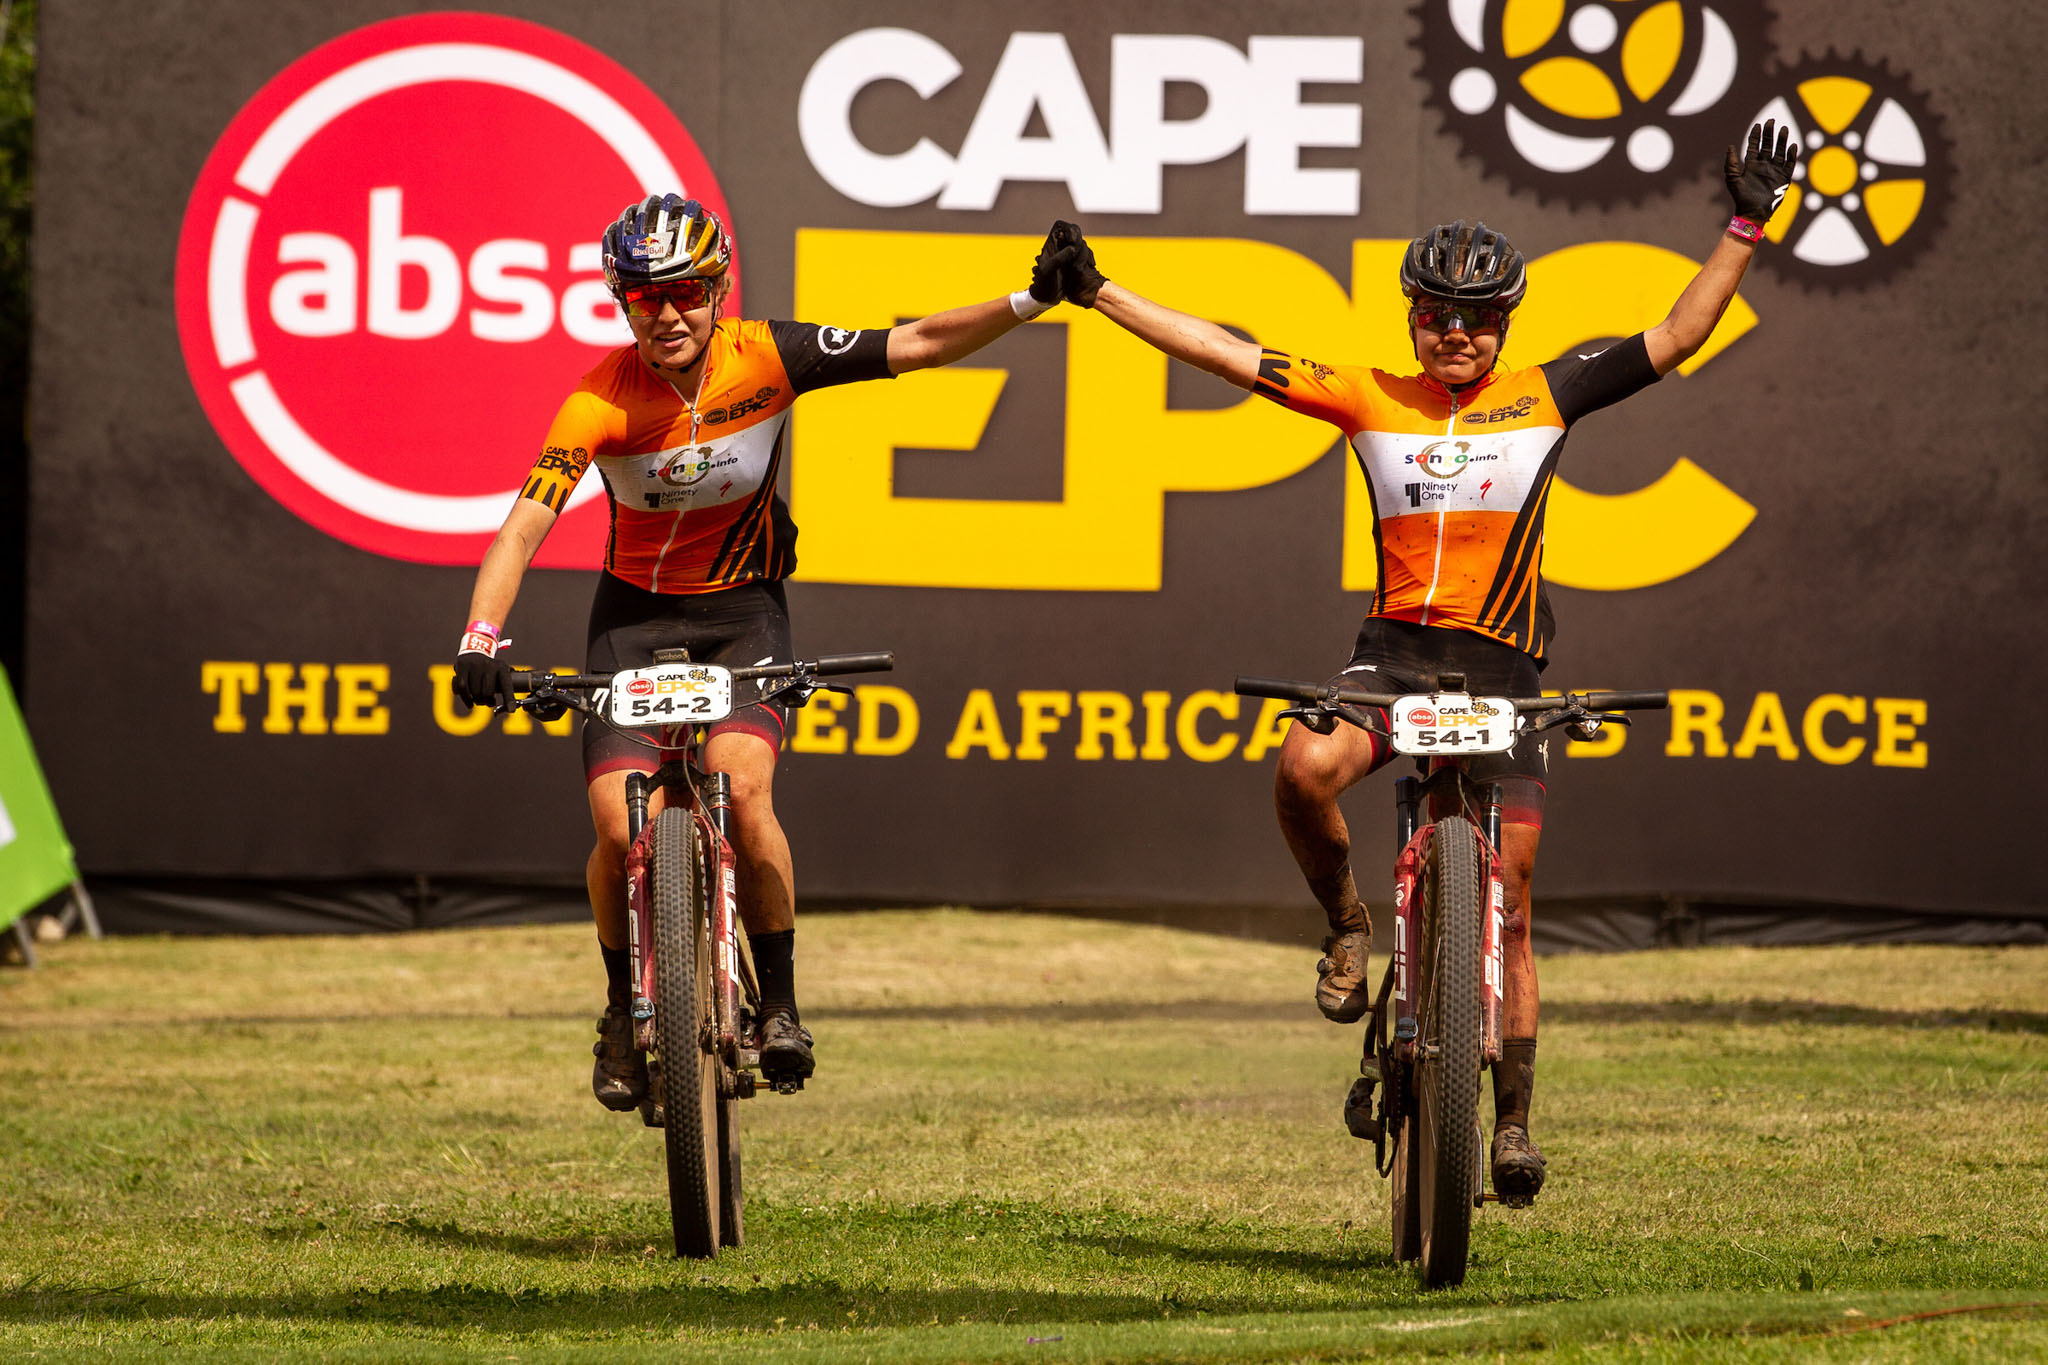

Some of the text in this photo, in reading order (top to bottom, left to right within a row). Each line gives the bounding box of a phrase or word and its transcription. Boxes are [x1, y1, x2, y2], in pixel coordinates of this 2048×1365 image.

[797, 27, 1364, 216] CAPE
[729, 398, 770, 421] EPIC
[1488, 406, 1531, 423] EPIC
[546, 446, 570, 458] CAPE
[537, 454, 581, 482] EPIC
[662, 488, 698, 499] Ninety
[1422, 481, 1458, 493] Ninety
[1421, 491, 1445, 500] One
[656, 674, 686, 682] CAPE
[656, 680, 706, 695] EPIC
[630, 696, 712, 717] 54-2
[1439, 707, 1469, 715] CAPE
[201, 660, 390, 735] THE
[946, 688, 1297, 763] AFRICA
[1665, 688, 1929, 768] RACE
[1411, 713, 1435, 721] absa
[1439, 715, 1489, 727] EPIC
[1416, 729, 1490, 747] 54-1
